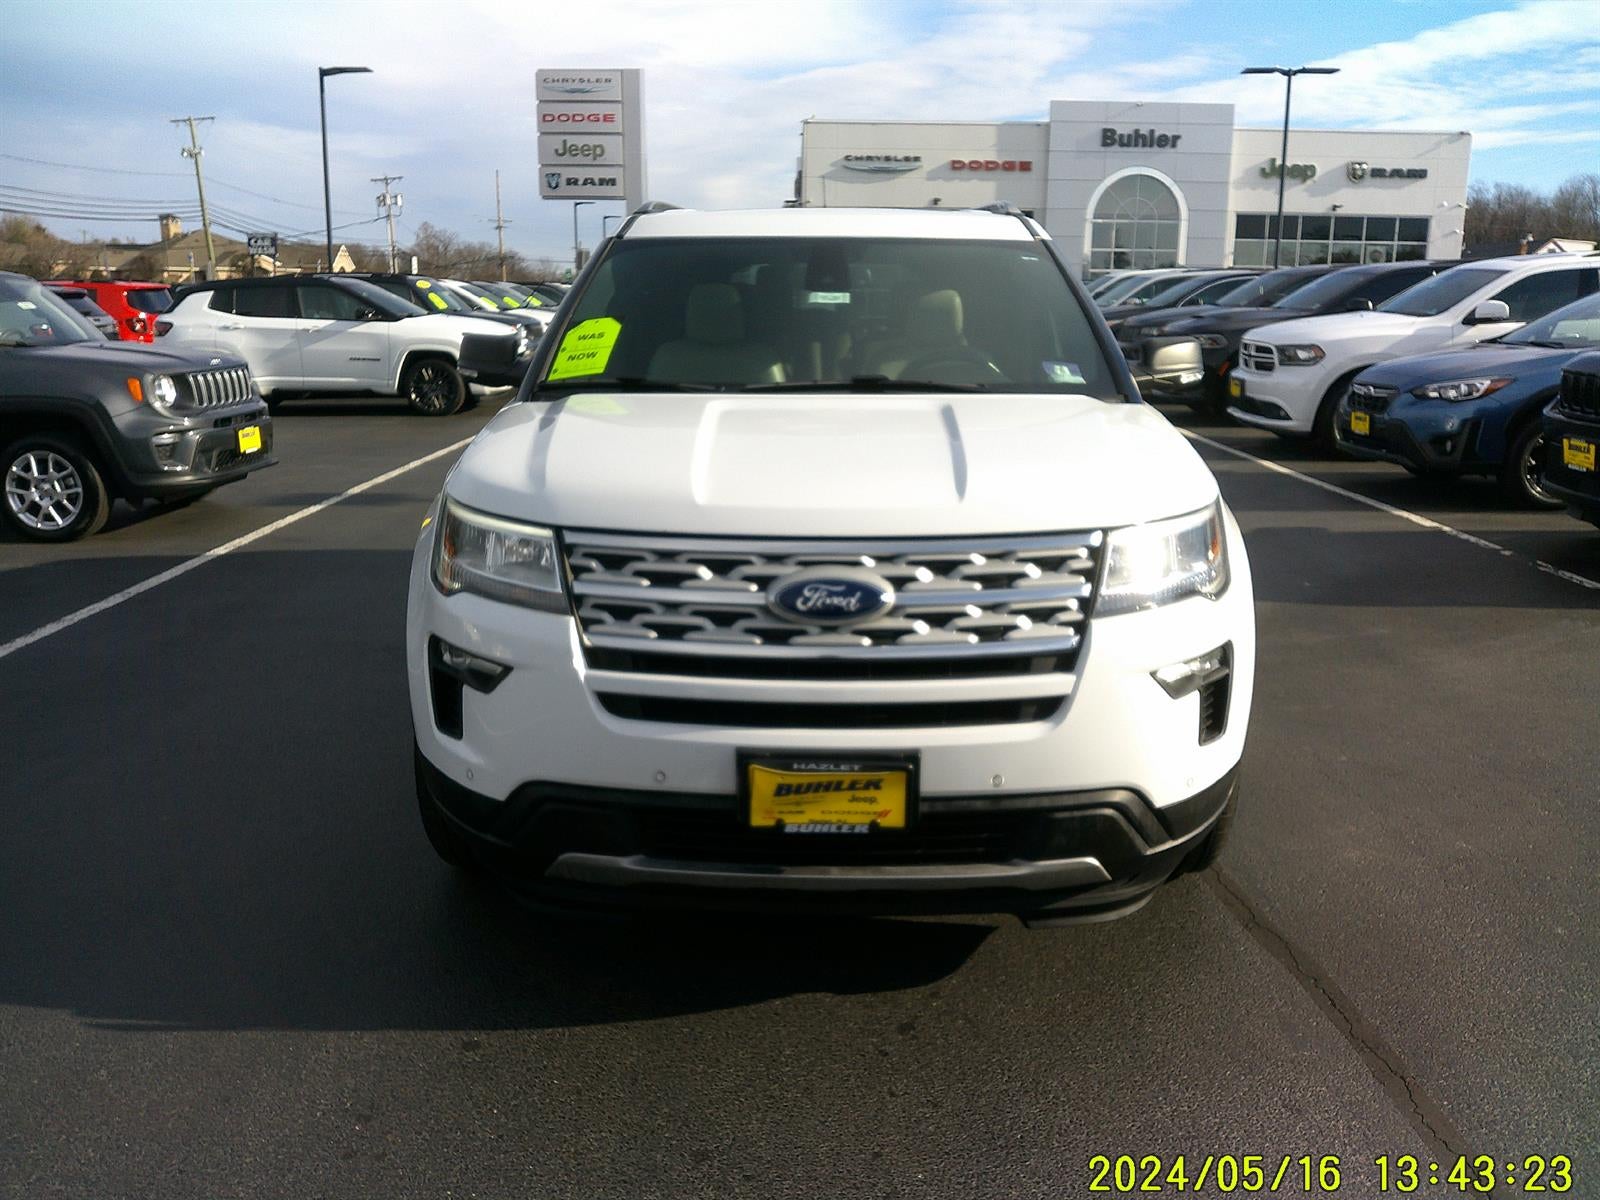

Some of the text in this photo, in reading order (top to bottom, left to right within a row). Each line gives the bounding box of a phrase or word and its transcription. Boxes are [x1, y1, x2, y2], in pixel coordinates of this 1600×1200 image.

[542, 113, 617, 123] DODGE
[1101, 127, 1182, 149] Buhler
[554, 139, 606, 161] Jeep
[844, 154, 922, 163] CHRYSLER
[951, 159, 1033, 172] DODGE
[1260, 157, 1317, 183] Jeep
[1370, 167, 1428, 179] RAM
[565, 177, 617, 187] RAM
[577, 331, 606, 341] WAS
[567, 351, 599, 362] NOW
[796, 583, 862, 612] Ford
[792, 763, 864, 771] HAZLET
[773, 778, 884, 798] BUHLER
[783, 823, 870, 834] BUHLER
